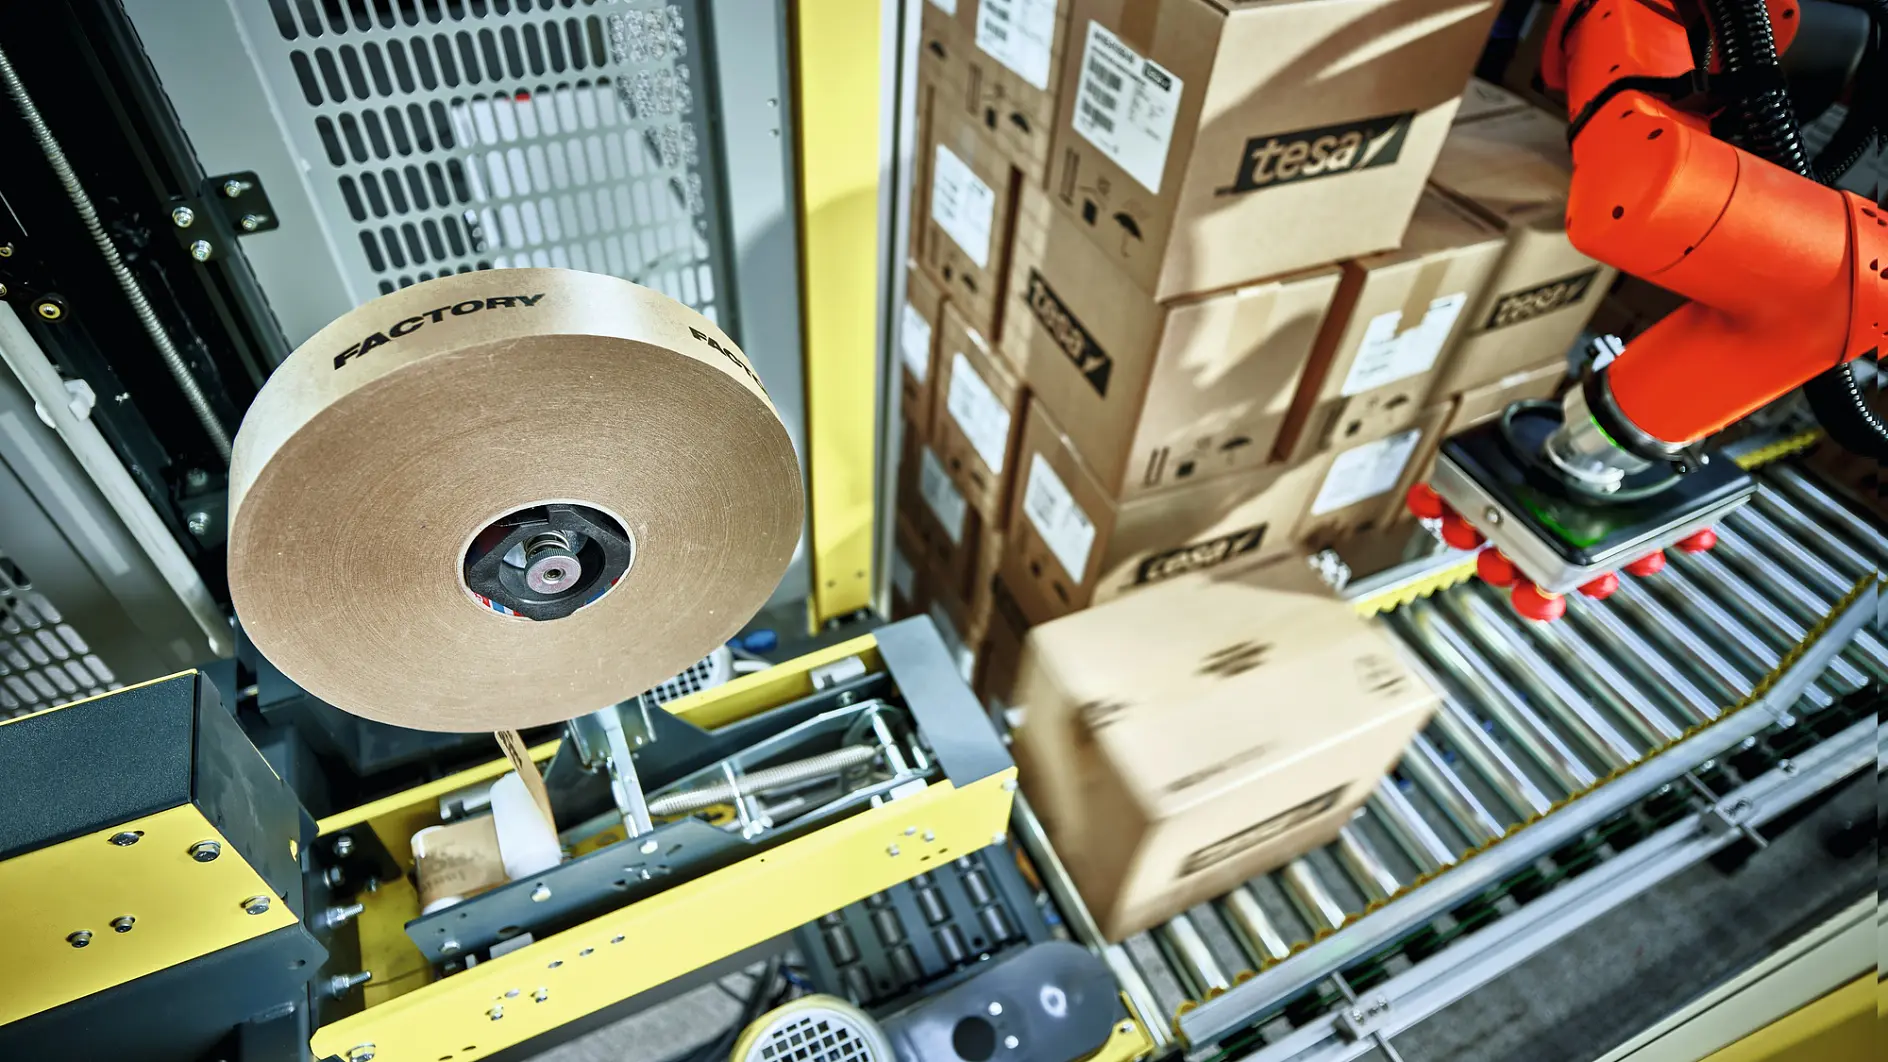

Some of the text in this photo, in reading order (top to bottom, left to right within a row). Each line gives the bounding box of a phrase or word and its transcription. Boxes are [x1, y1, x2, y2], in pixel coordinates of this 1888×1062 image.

[1250, 131, 1364, 186] tesa
[333, 293, 546, 371] FACTORY
[1031, 280, 1086, 360] tesa
[688, 326, 769, 397] FACTO
